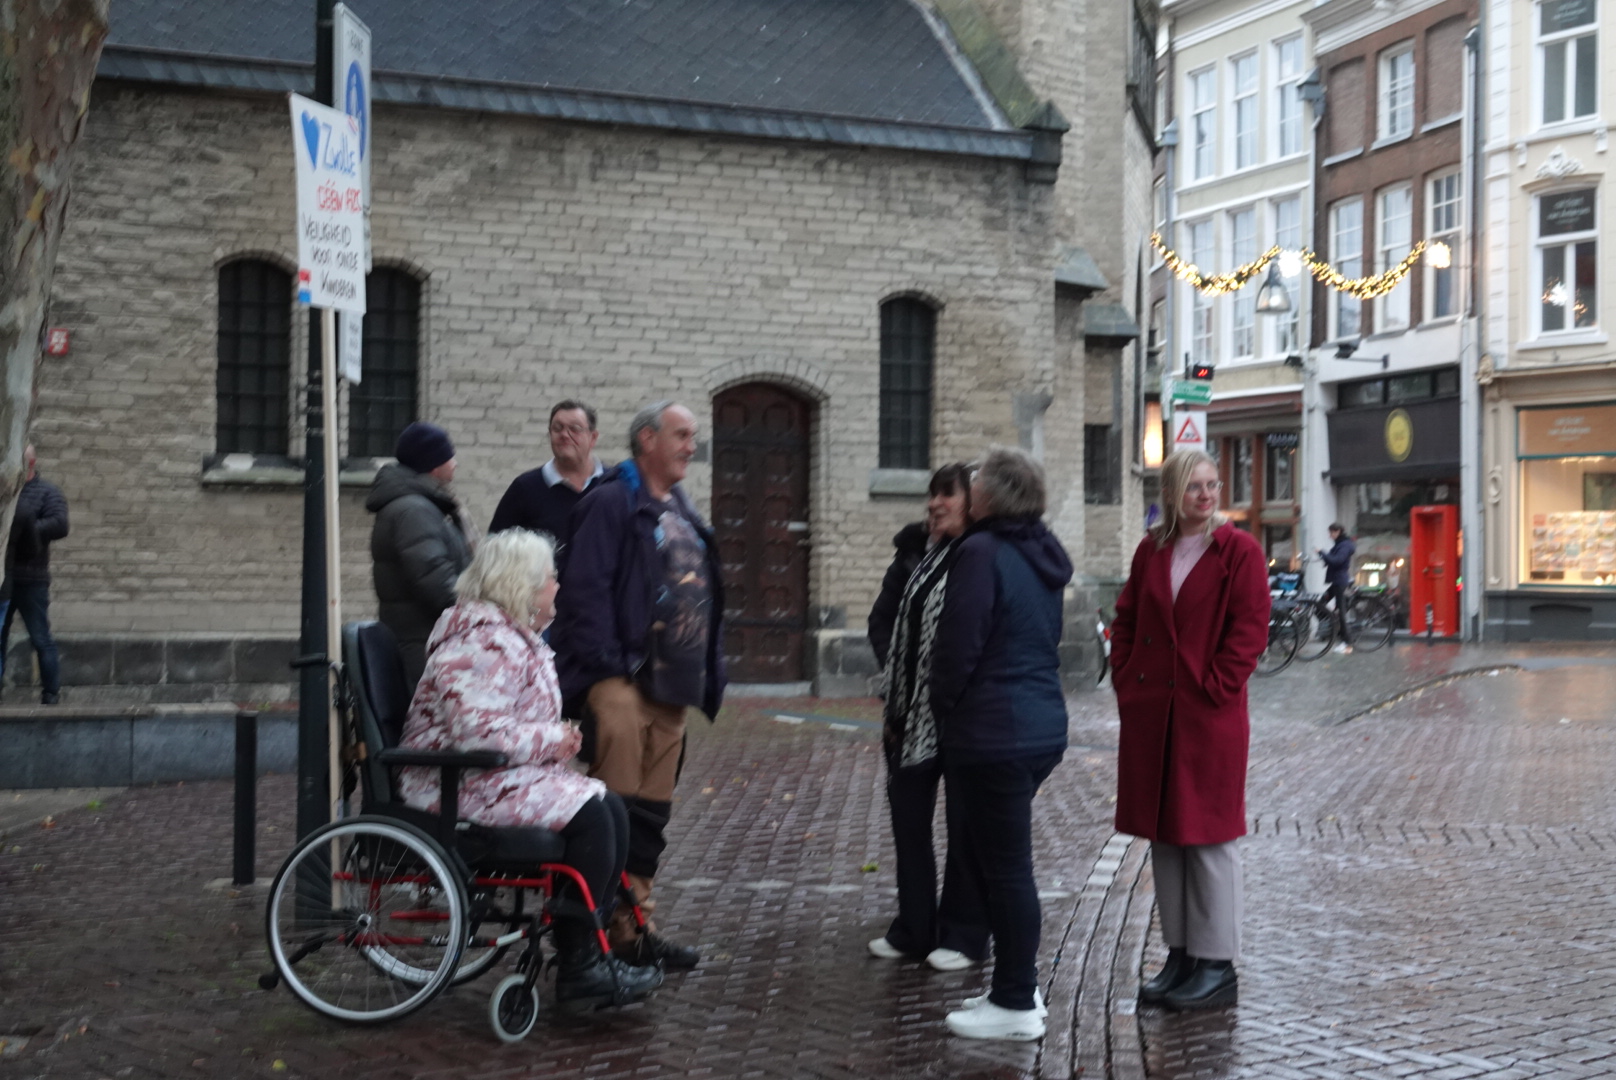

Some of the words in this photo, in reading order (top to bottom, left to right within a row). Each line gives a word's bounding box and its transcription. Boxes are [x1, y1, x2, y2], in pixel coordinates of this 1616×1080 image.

[321, 122, 356, 177] Zwolle
[312, 246, 332, 265] VOOR
[336, 251, 358, 272] ONZE
